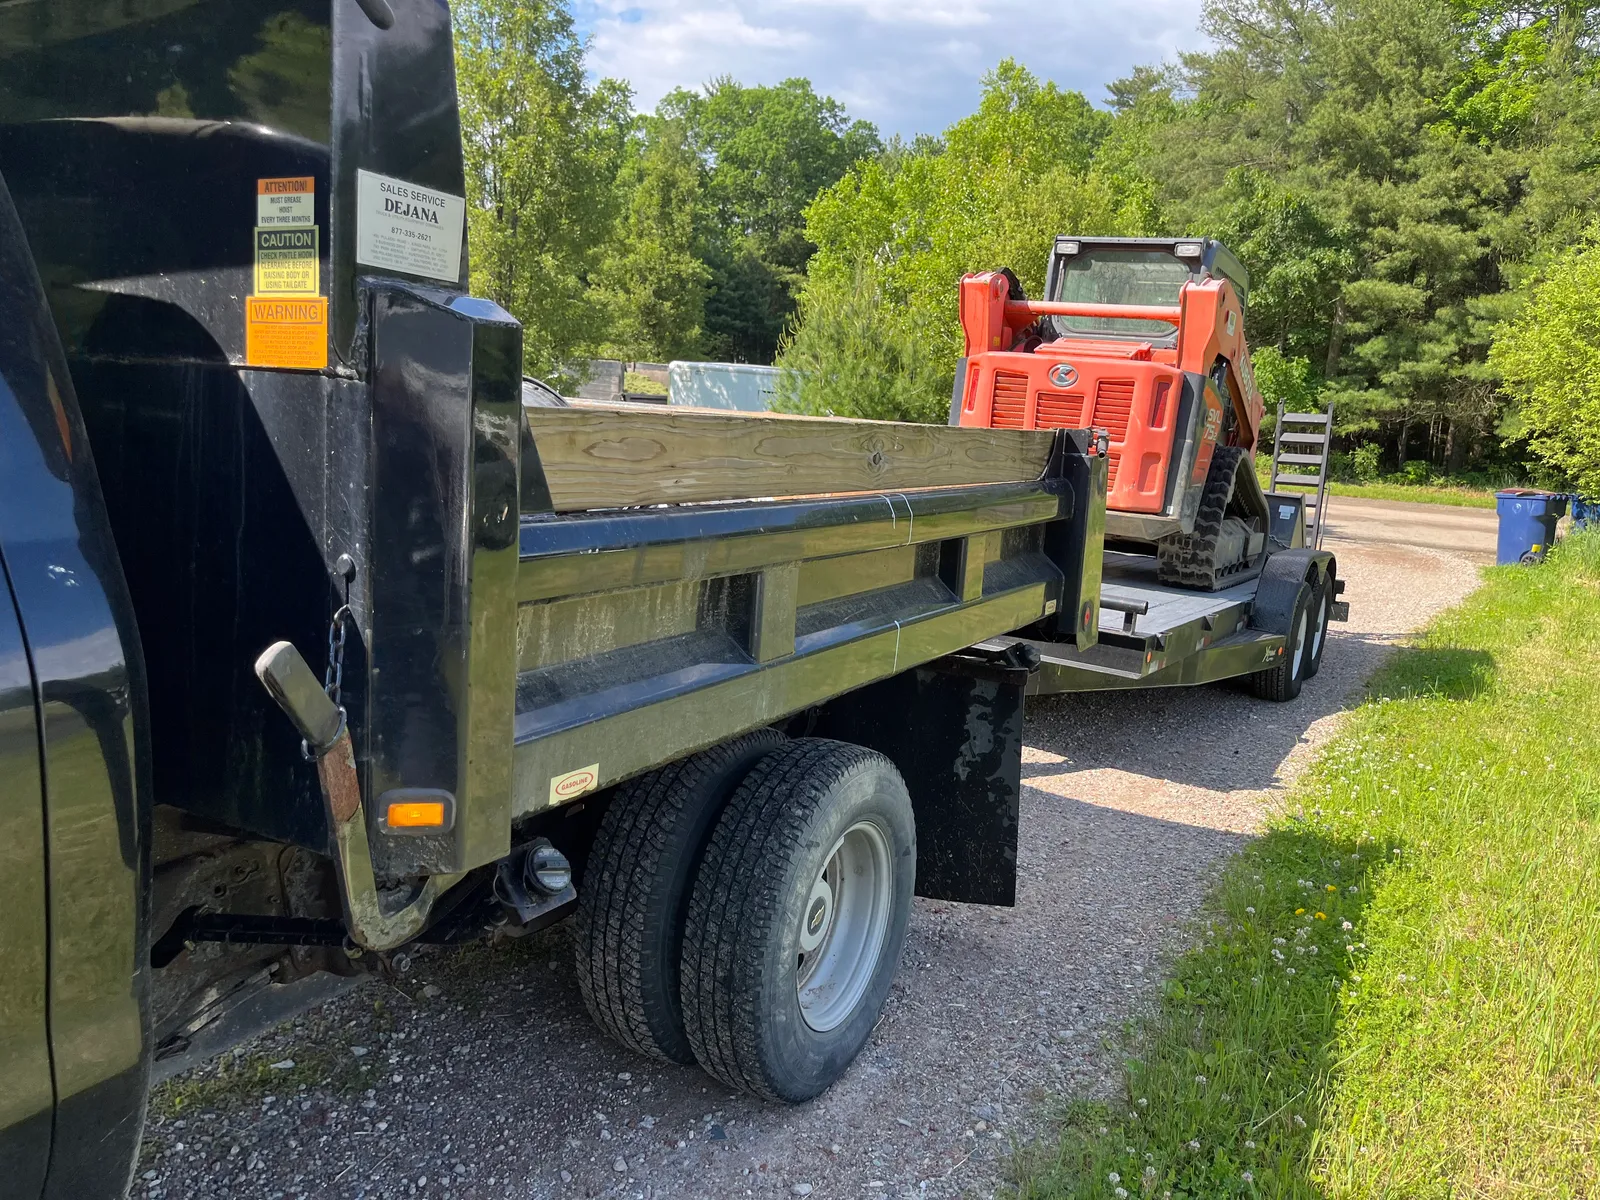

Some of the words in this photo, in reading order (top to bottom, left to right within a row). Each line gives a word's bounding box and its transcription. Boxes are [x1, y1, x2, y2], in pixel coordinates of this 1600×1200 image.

[264, 180, 308, 193] ATTENTION!
[270, 196, 283, 204] MUST
[380, 182, 409, 198] SALES
[411, 190, 446, 208] SERVICE
[384, 197, 439, 224] DEJANA
[261, 233, 312, 247] CAUTION
[391, 226, 432, 242] 877-335-2621
[261, 252, 278, 260] CHECK
[279, 251, 297, 259] PINTLE
[298, 251, 313, 259] HOOK
[261, 261, 291, 269] CLEARANCE
[292, 261, 312, 269] BEFORE
[264, 271, 285, 279] RAISING
[286, 271, 301, 279] BODY
[301, 271, 310, 279] OR
[265, 281, 282, 289] USING
[283, 280, 307, 288] TAILGATE
[253, 304, 319, 320] WARNING
[561, 776, 589, 791] GASOLINE
